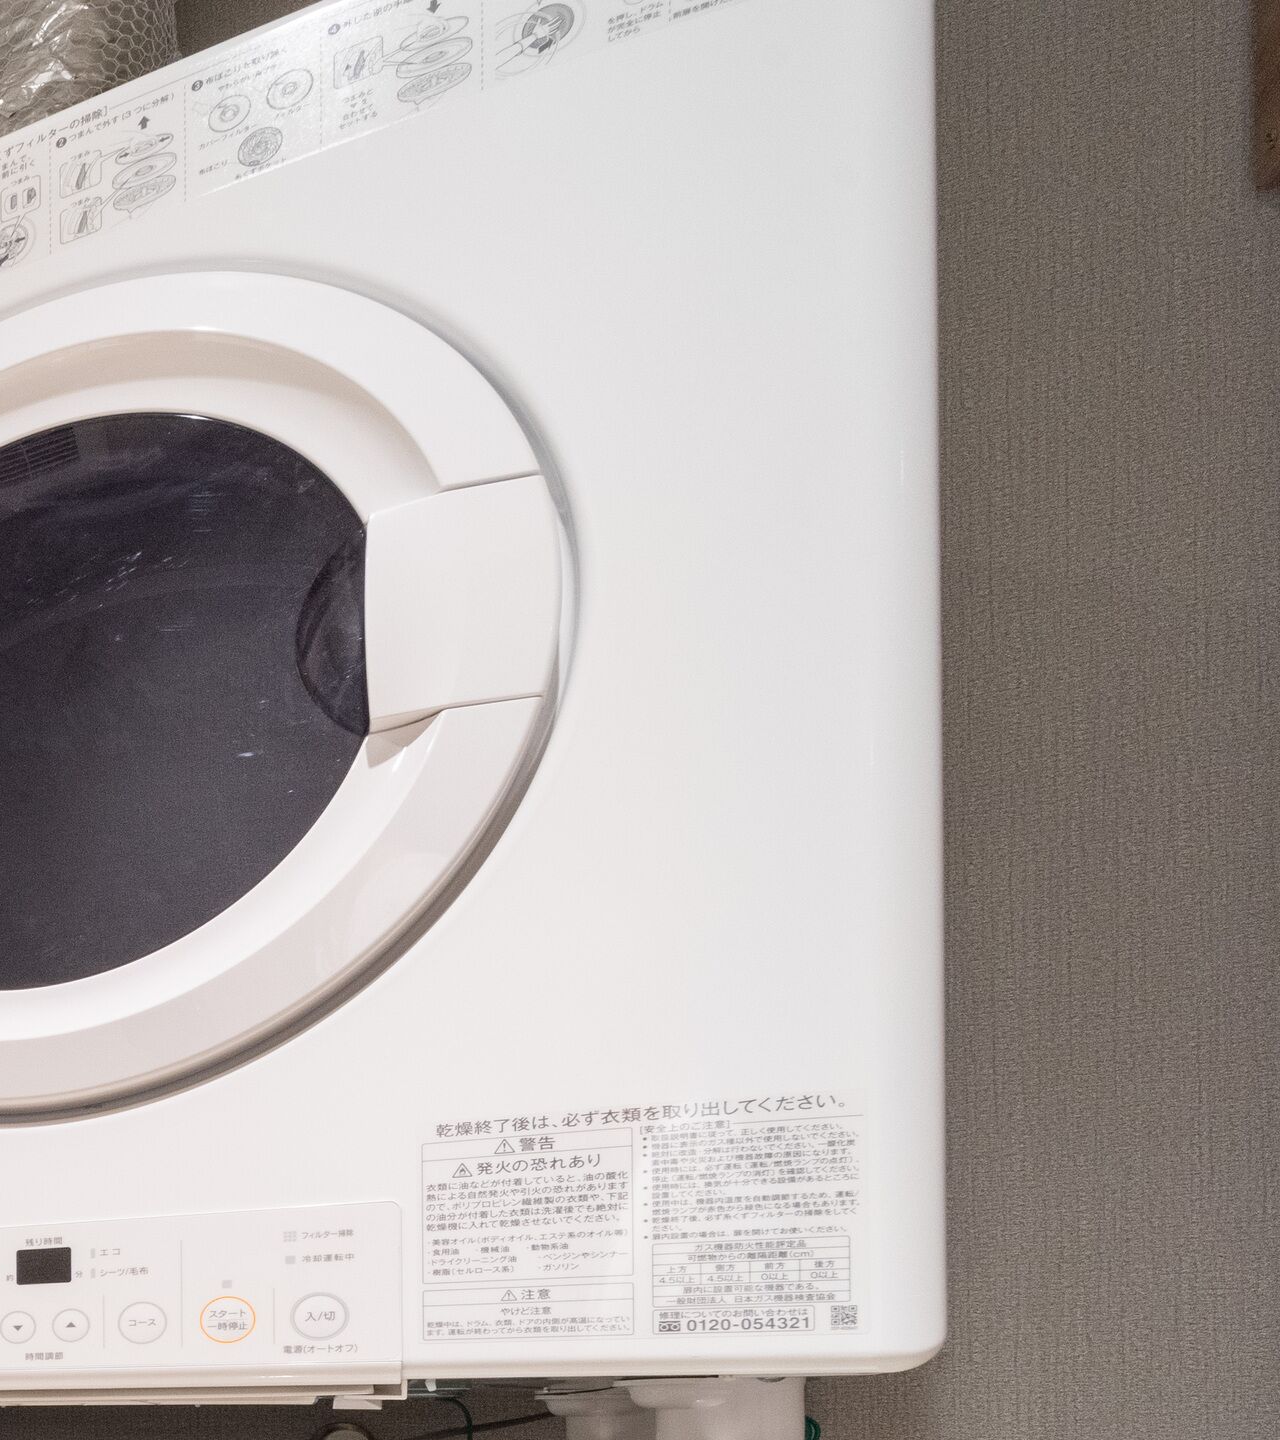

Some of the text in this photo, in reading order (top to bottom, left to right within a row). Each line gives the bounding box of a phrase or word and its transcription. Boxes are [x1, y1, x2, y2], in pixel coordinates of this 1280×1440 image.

[436, 1094, 846, 1138] 乾燥終了後は、必ず衣類を取り出してください。
[519, 1136, 556, 1151] 警告
[477, 1153, 601, 1176] 発火の恐れあり
[25, 1237, 63, 1247] 残り時間
[99, 1248, 121, 1257] エコ
[302, 1253, 355, 1263] 冷却運転中
[99, 1266, 149, 1277] シーツ/毛布
[521, 1288, 551, 1300] 注意
[208, 1308, 247, 1319] スタート
[305, 1311, 336, 1322] 入/切
[501, 1306, 551, 1316] やけど注意
[128, 1317, 157, 1327] コース
[207, 1321, 248, 1331] 一時停止
[686, 1317, 810, 1332] 0120-054321
